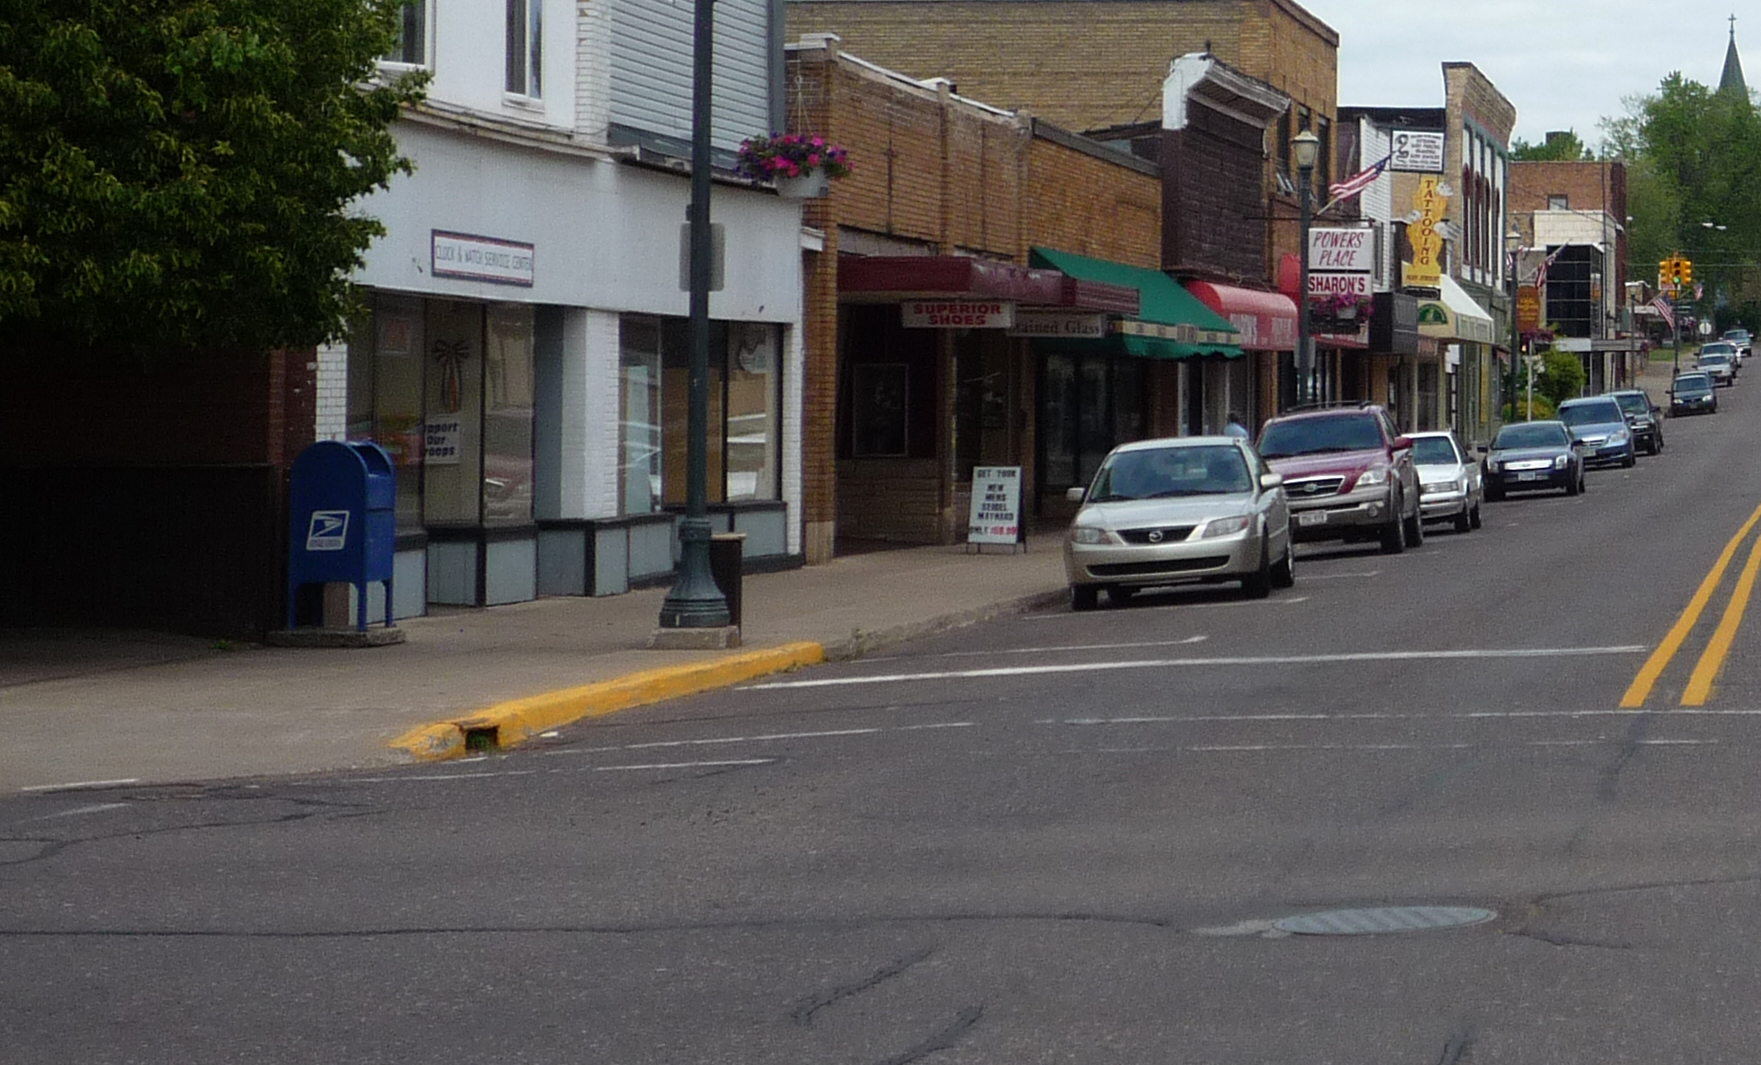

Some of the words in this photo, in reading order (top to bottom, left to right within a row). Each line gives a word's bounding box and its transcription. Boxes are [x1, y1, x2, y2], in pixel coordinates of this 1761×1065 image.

[1420, 180, 1434, 266] TATTOOING
[1313, 232, 1364, 248] POWERS
[1318, 249, 1358, 267] PLACE
[1308, 275, 1366, 293] SHARON'S
[913, 303, 1002, 315] SUPERIOR
[927, 314, 987, 326] SHOES
